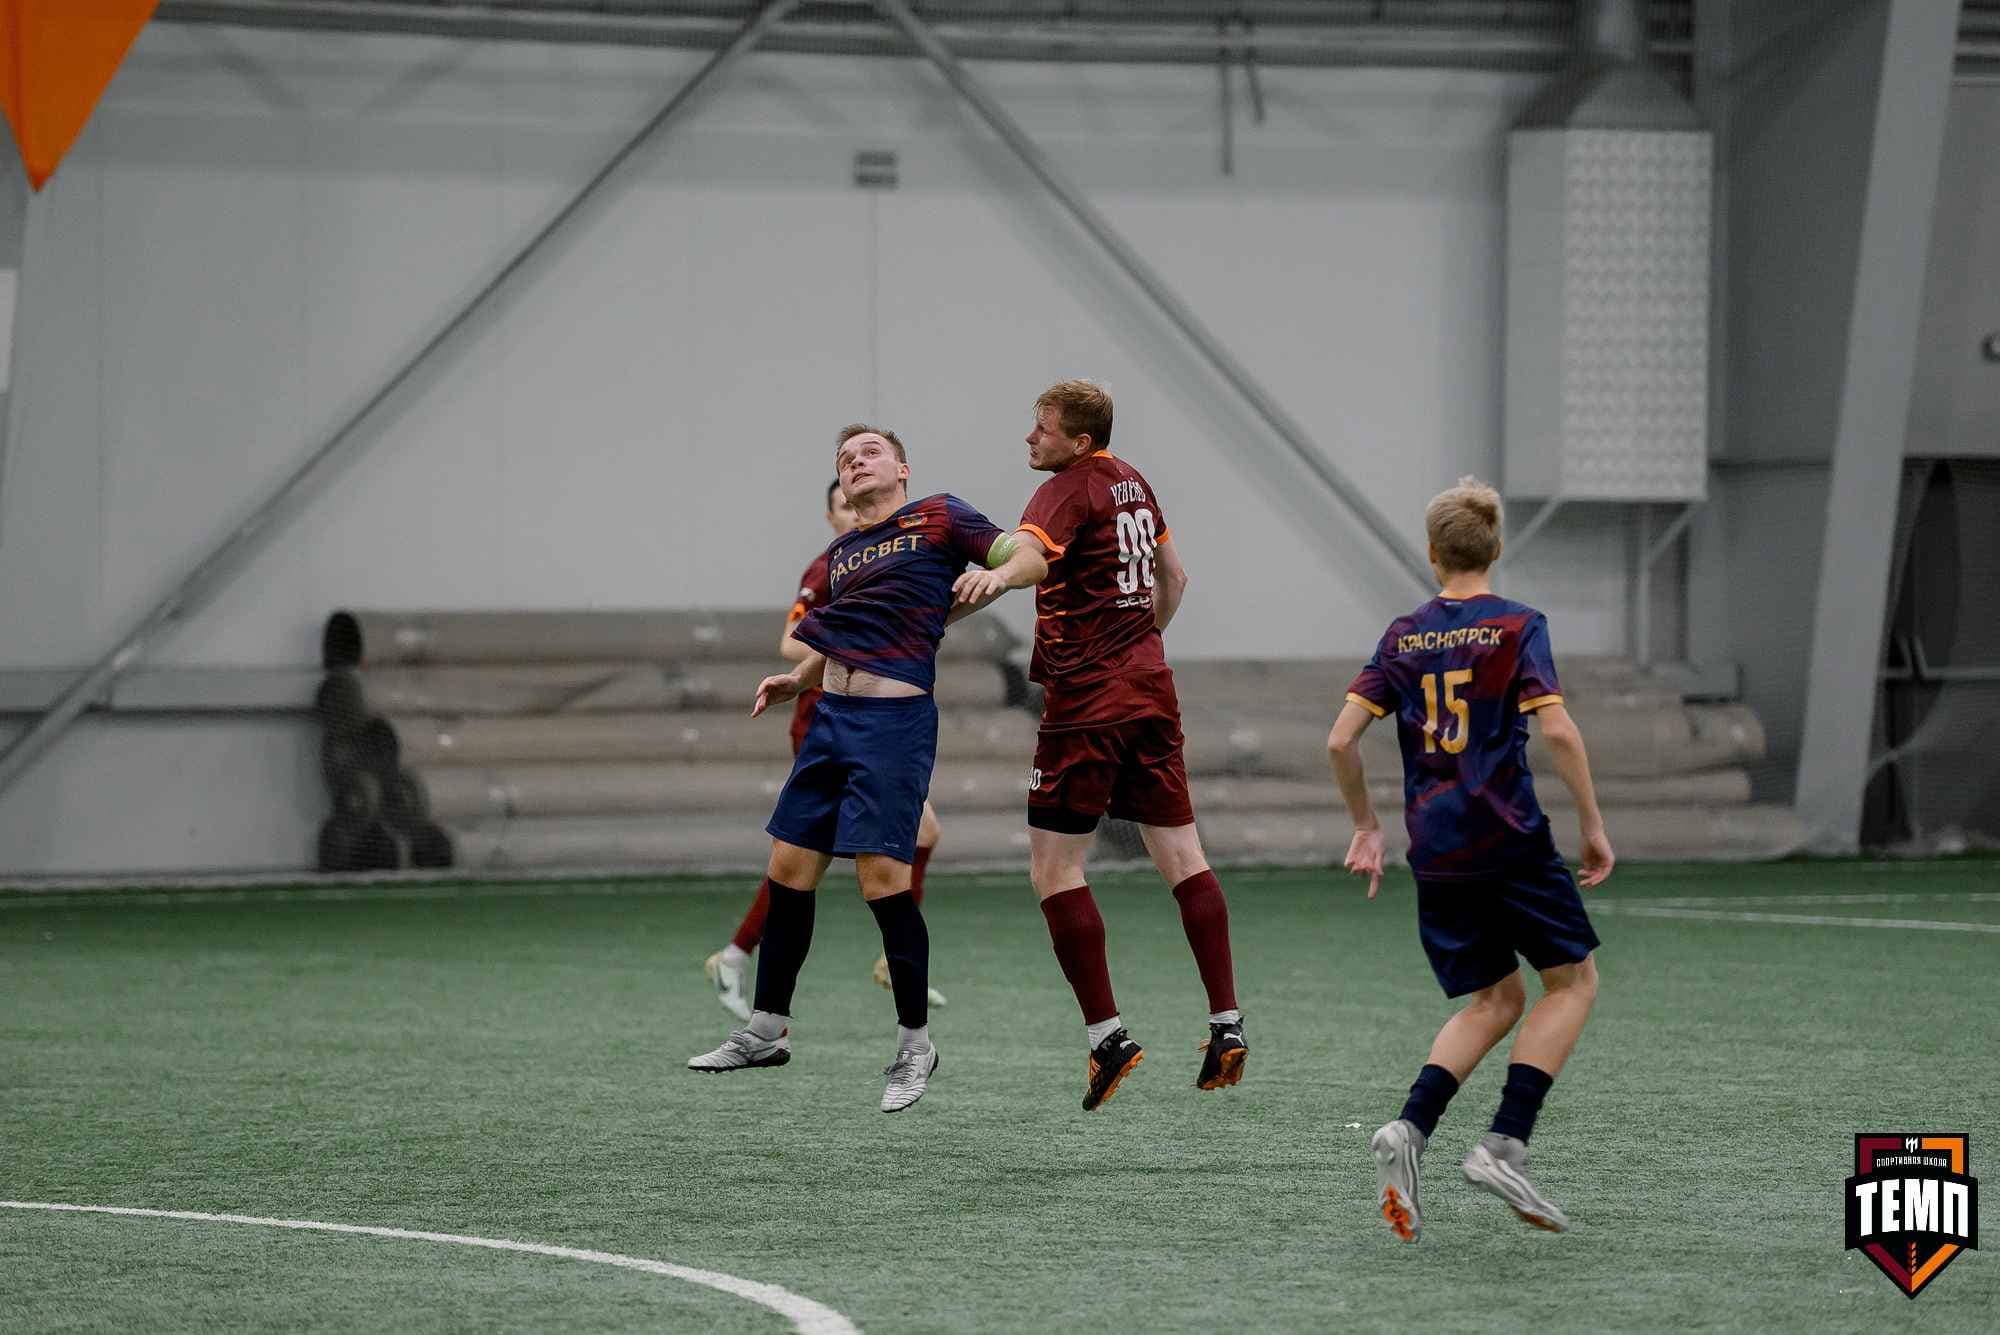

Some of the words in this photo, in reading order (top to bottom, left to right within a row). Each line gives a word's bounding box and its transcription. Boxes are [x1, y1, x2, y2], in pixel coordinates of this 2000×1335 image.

[830, 534, 922, 591] РАССВЕТ
[1116, 508, 1157, 594] 90
[1397, 627, 1503, 654] КРАСНОЯРСК
[1420, 668, 1473, 755] 15
